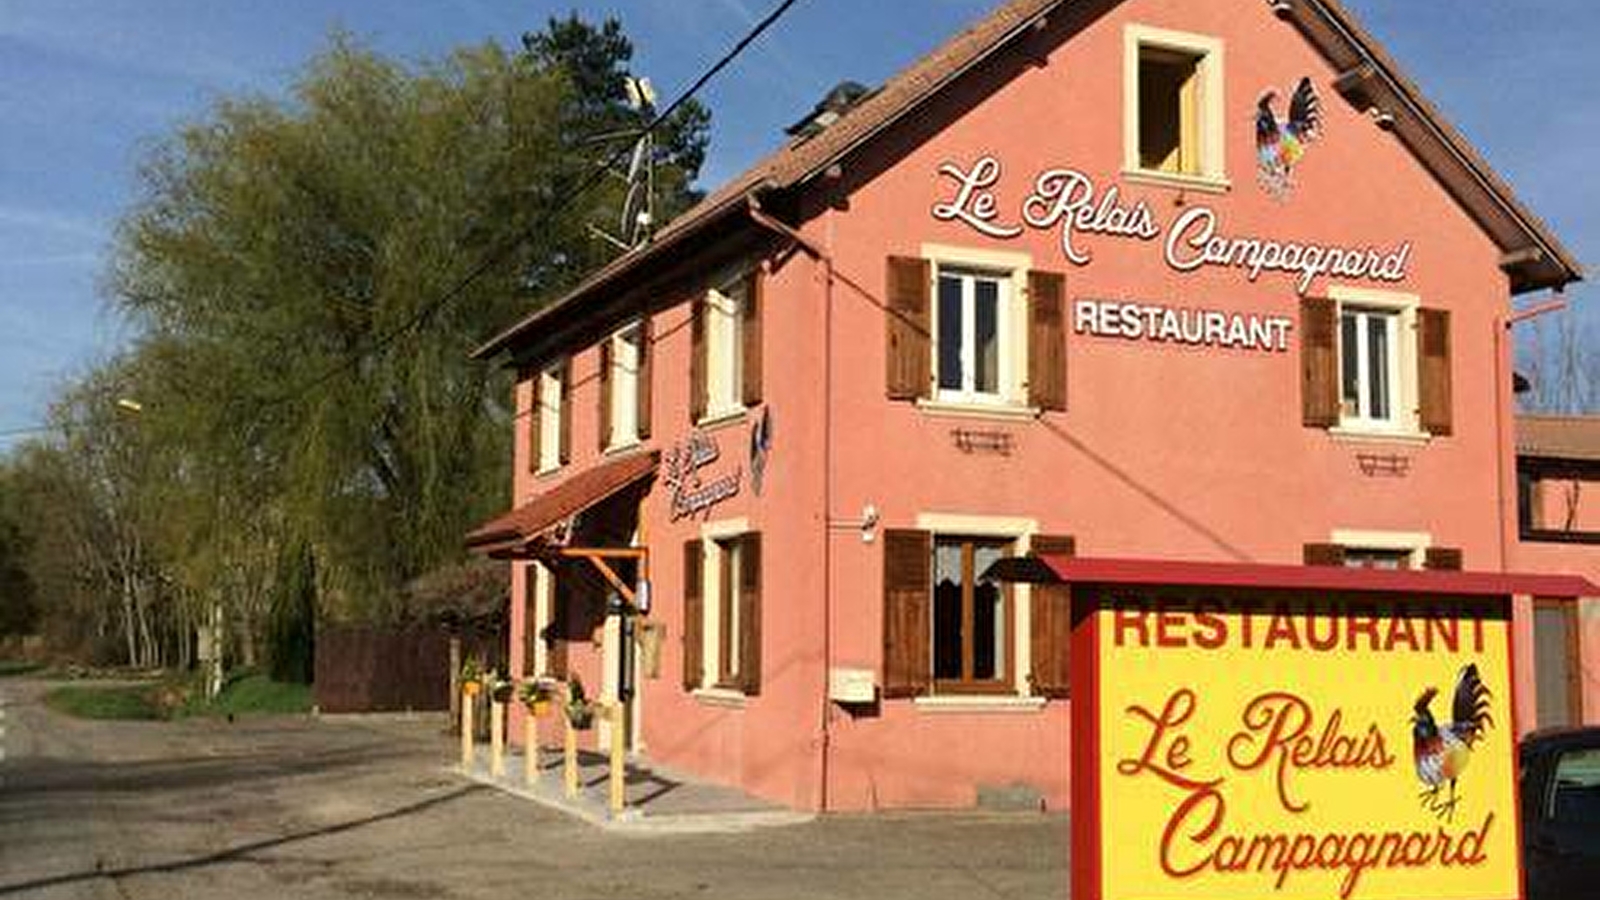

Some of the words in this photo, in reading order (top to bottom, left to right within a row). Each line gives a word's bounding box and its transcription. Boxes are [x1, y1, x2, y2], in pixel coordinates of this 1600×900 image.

[933, 156, 1022, 238] Le
[1023, 168, 1159, 264] Relais
[1165, 207, 1411, 293] Campagnard
[1074, 300, 1294, 352] RESTAURANT
[1113, 602, 1491, 654] RESTAURANT
[1117, 688, 1223, 792] Le
[1227, 691, 1396, 813] Relais
[1160, 788, 1494, 899] Campagnard
